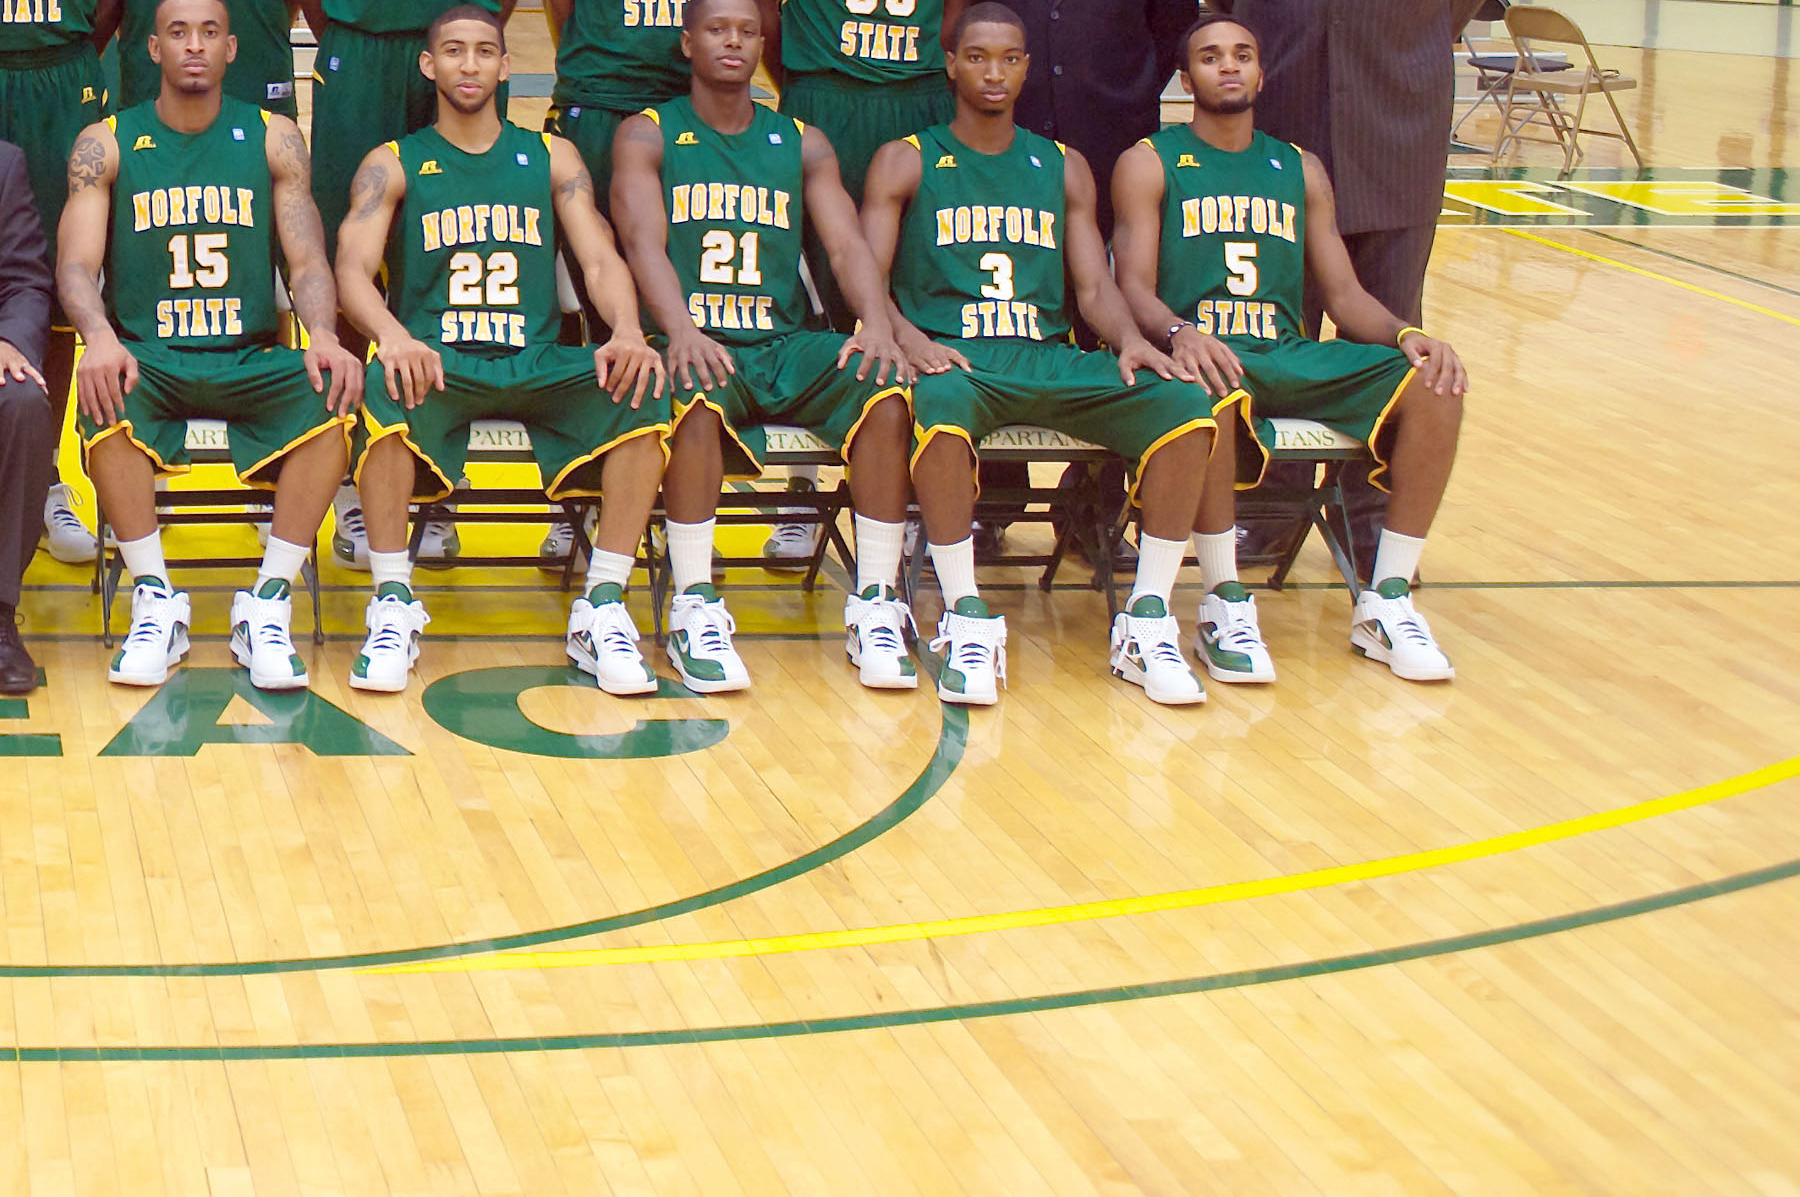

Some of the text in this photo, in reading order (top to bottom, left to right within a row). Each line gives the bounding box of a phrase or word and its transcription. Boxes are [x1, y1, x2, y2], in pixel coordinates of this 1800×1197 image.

[840, 21, 919, 62] STATE
[132, 186, 254, 232] NORFOLK
[421, 204, 543, 252] NORFOLK
[671, 183, 791, 230] NORFOLK
[936, 206, 1056, 249] NORFOLK
[1182, 196, 1296, 243] NORFOLK
[168, 233, 229, 289] 15
[448, 251, 519, 305] 22
[699, 230, 762, 286] 21
[979, 253, 1014, 301] 3
[1224, 242, 1258, 296] 5
[156, 298, 242, 338] STATE
[441, 311, 526, 348] STATE
[688, 293, 773, 331] STATE
[962, 301, 1043, 341] STATE
[1196, 300, 1277, 340] STATE
